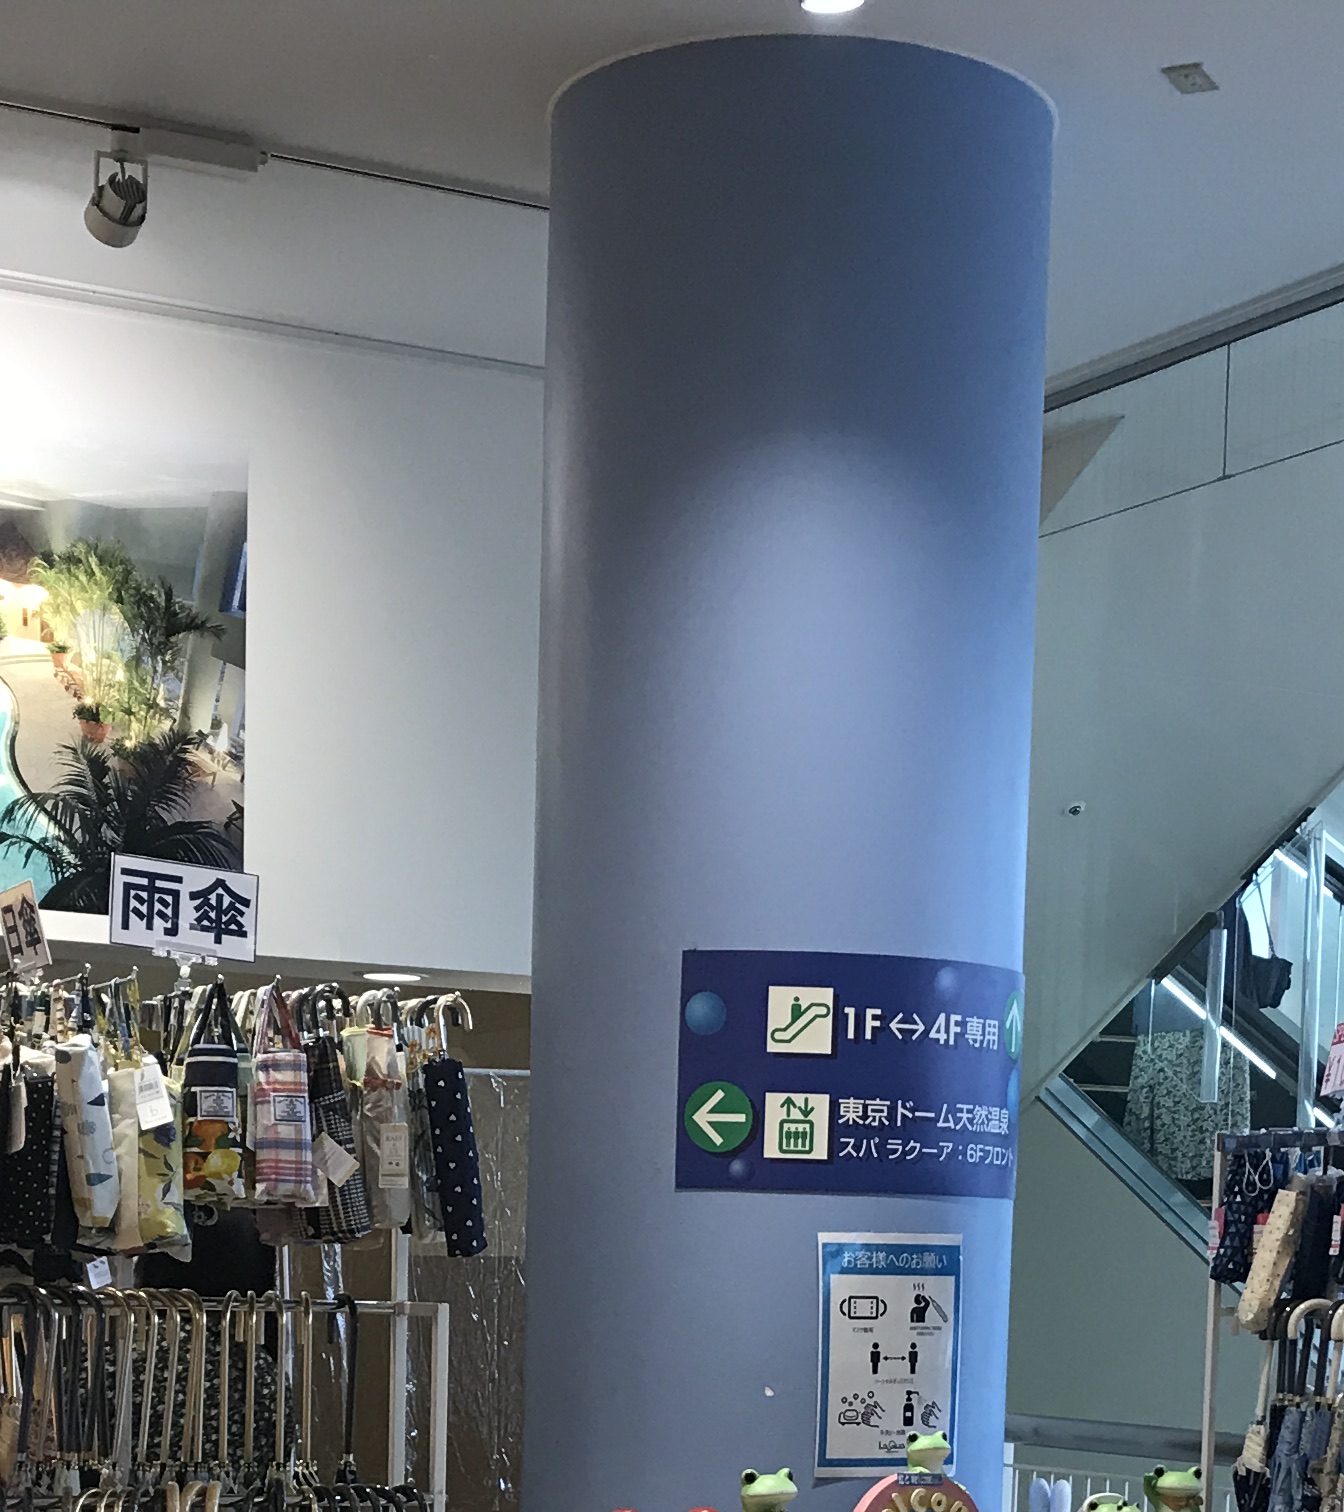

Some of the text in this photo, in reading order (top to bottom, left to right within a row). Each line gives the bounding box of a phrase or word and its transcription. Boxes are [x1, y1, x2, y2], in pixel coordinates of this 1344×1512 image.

[1, 893, 42, 957] 日傘
[120, 867, 251, 944] 雨傘
[844, 1007, 881, 1040] 1F
[838, 1097, 1009, 1136] 東京ドーム天然温泉
[842, 1251, 948, 1269] お客様へのお願い
